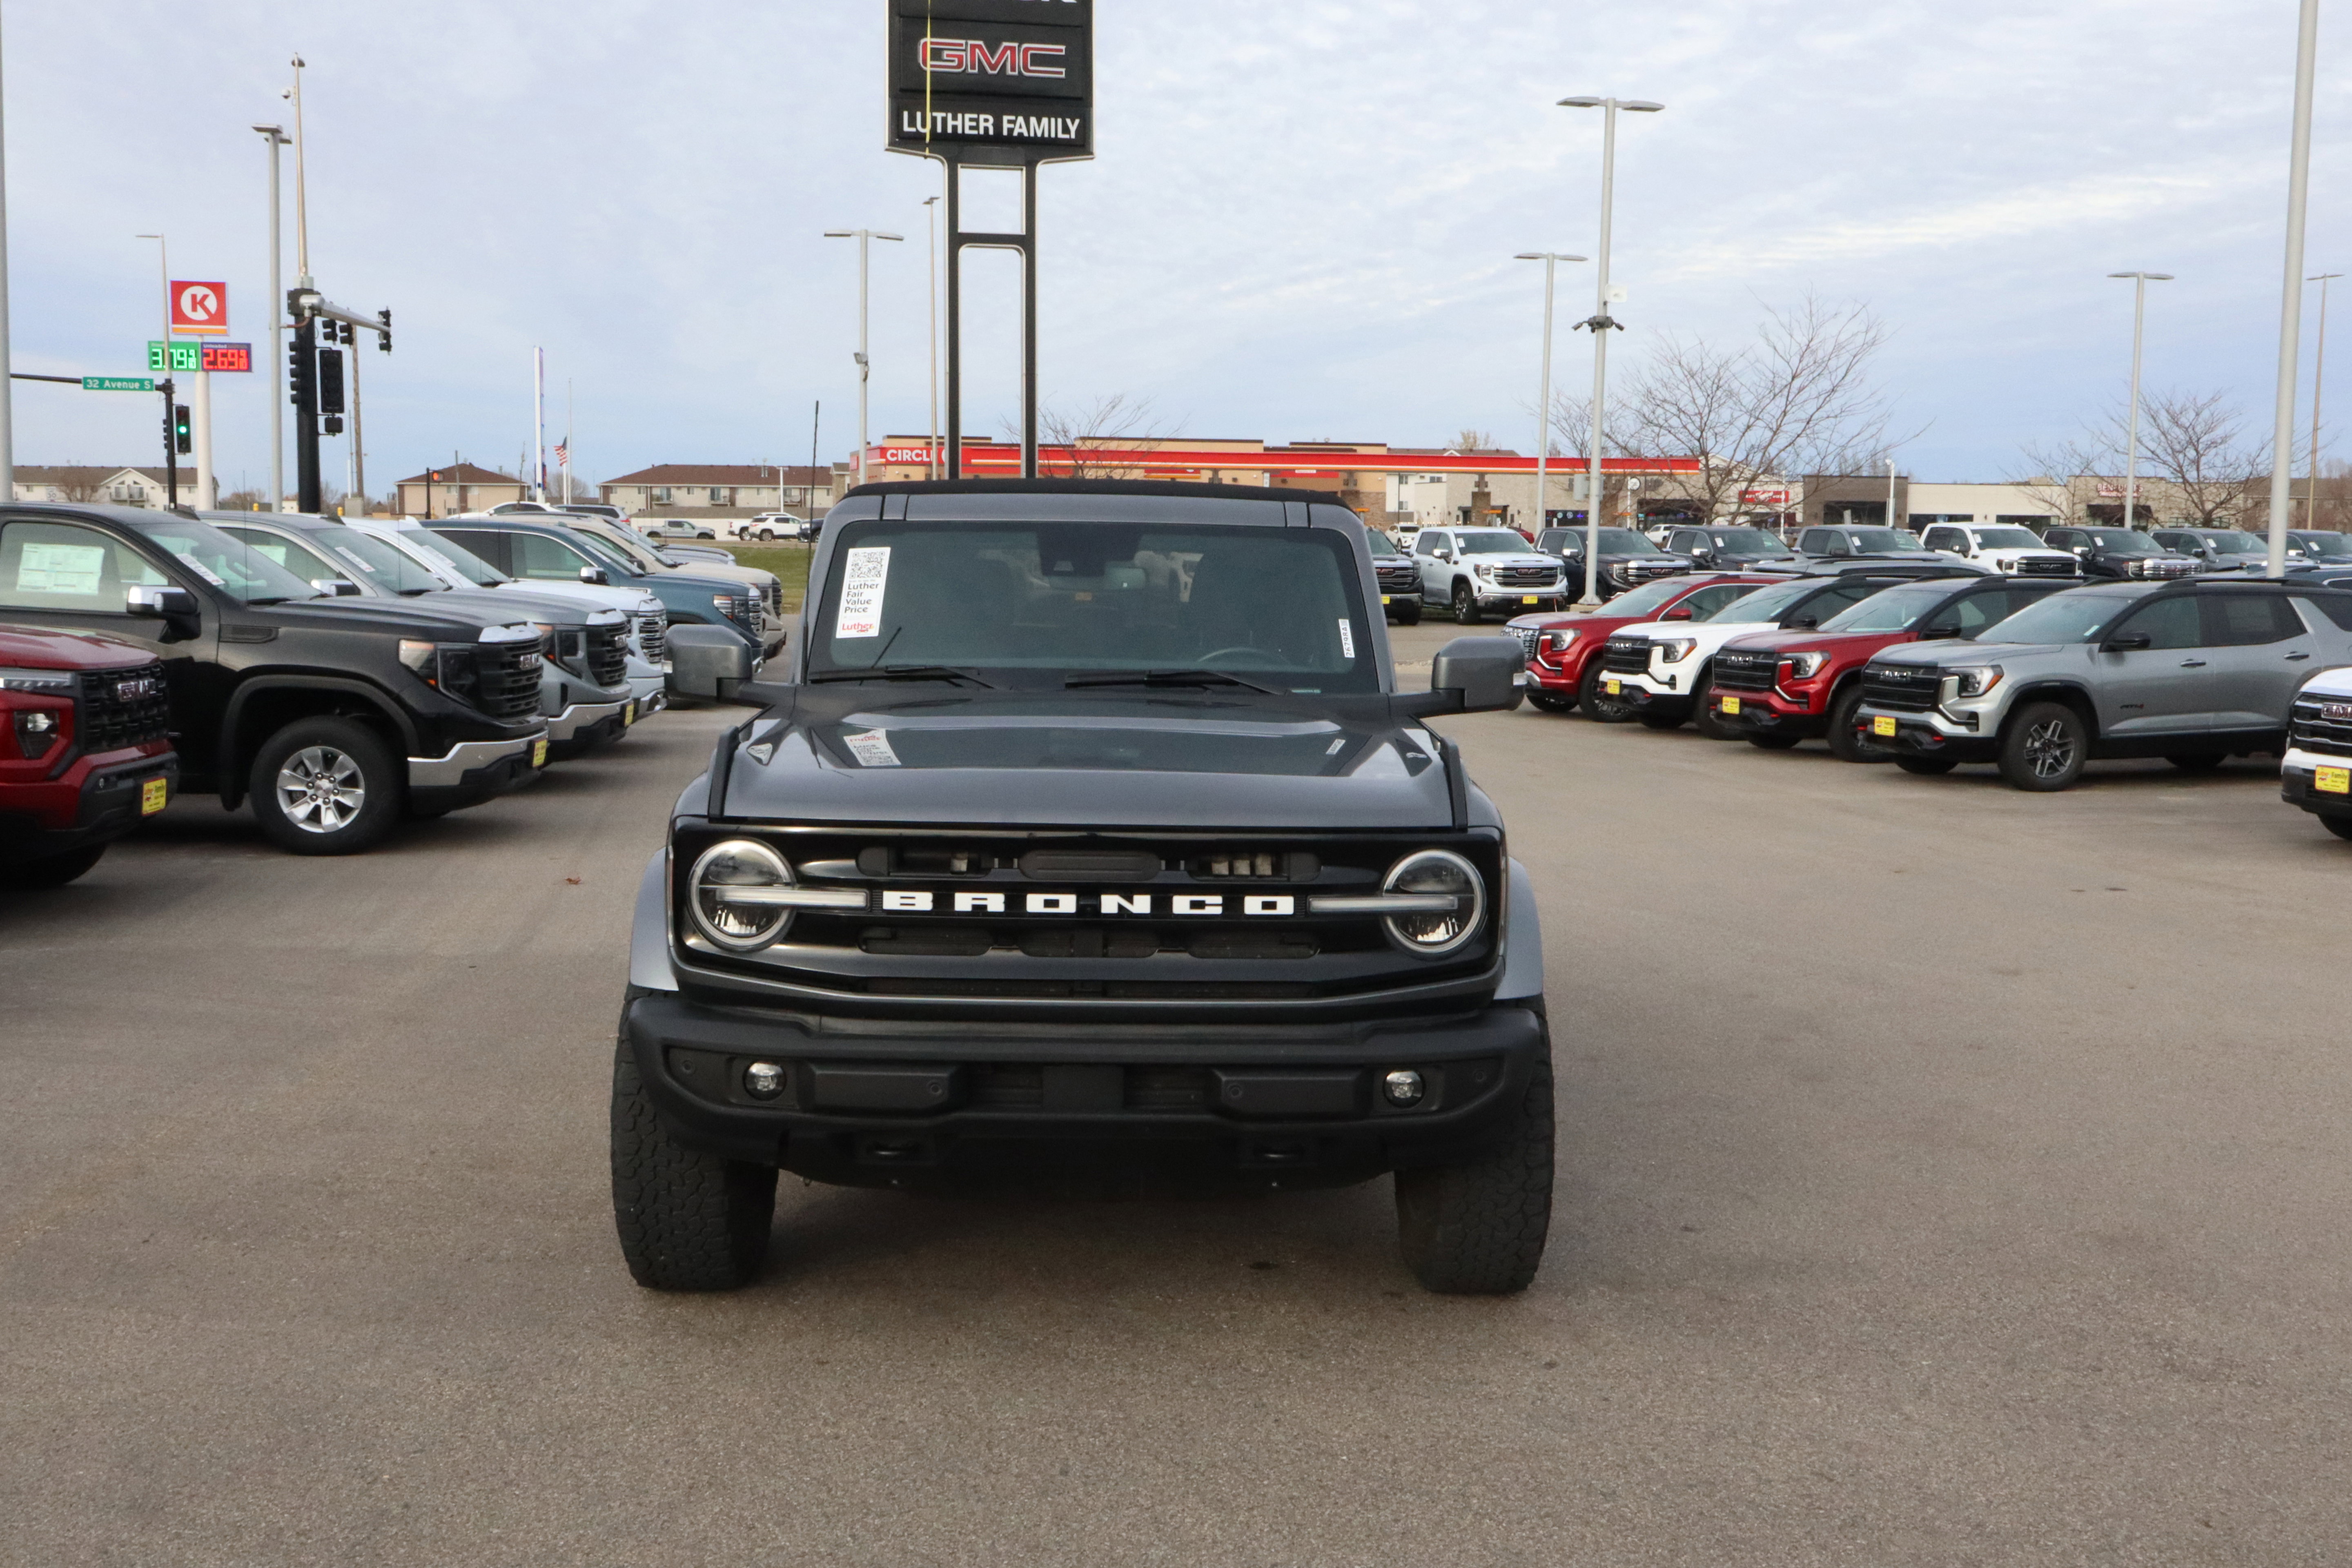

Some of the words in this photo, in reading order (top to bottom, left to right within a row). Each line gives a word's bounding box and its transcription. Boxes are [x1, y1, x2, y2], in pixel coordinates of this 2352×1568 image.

[919, 38, 1065, 78] GMC
[903, 111, 994, 136] LUTHER
[1002, 116, 1080, 139] FAMILY
[191, 294, 215, 319] K
[203, 348, 239, 370] 2.69
[87, 379, 99, 388] 32
[103, 379, 140, 389] Avenue
[144, 380, 151, 389] S
[842, 622, 874, 631] Luther
[882, 890, 1294, 915] BRONCO
